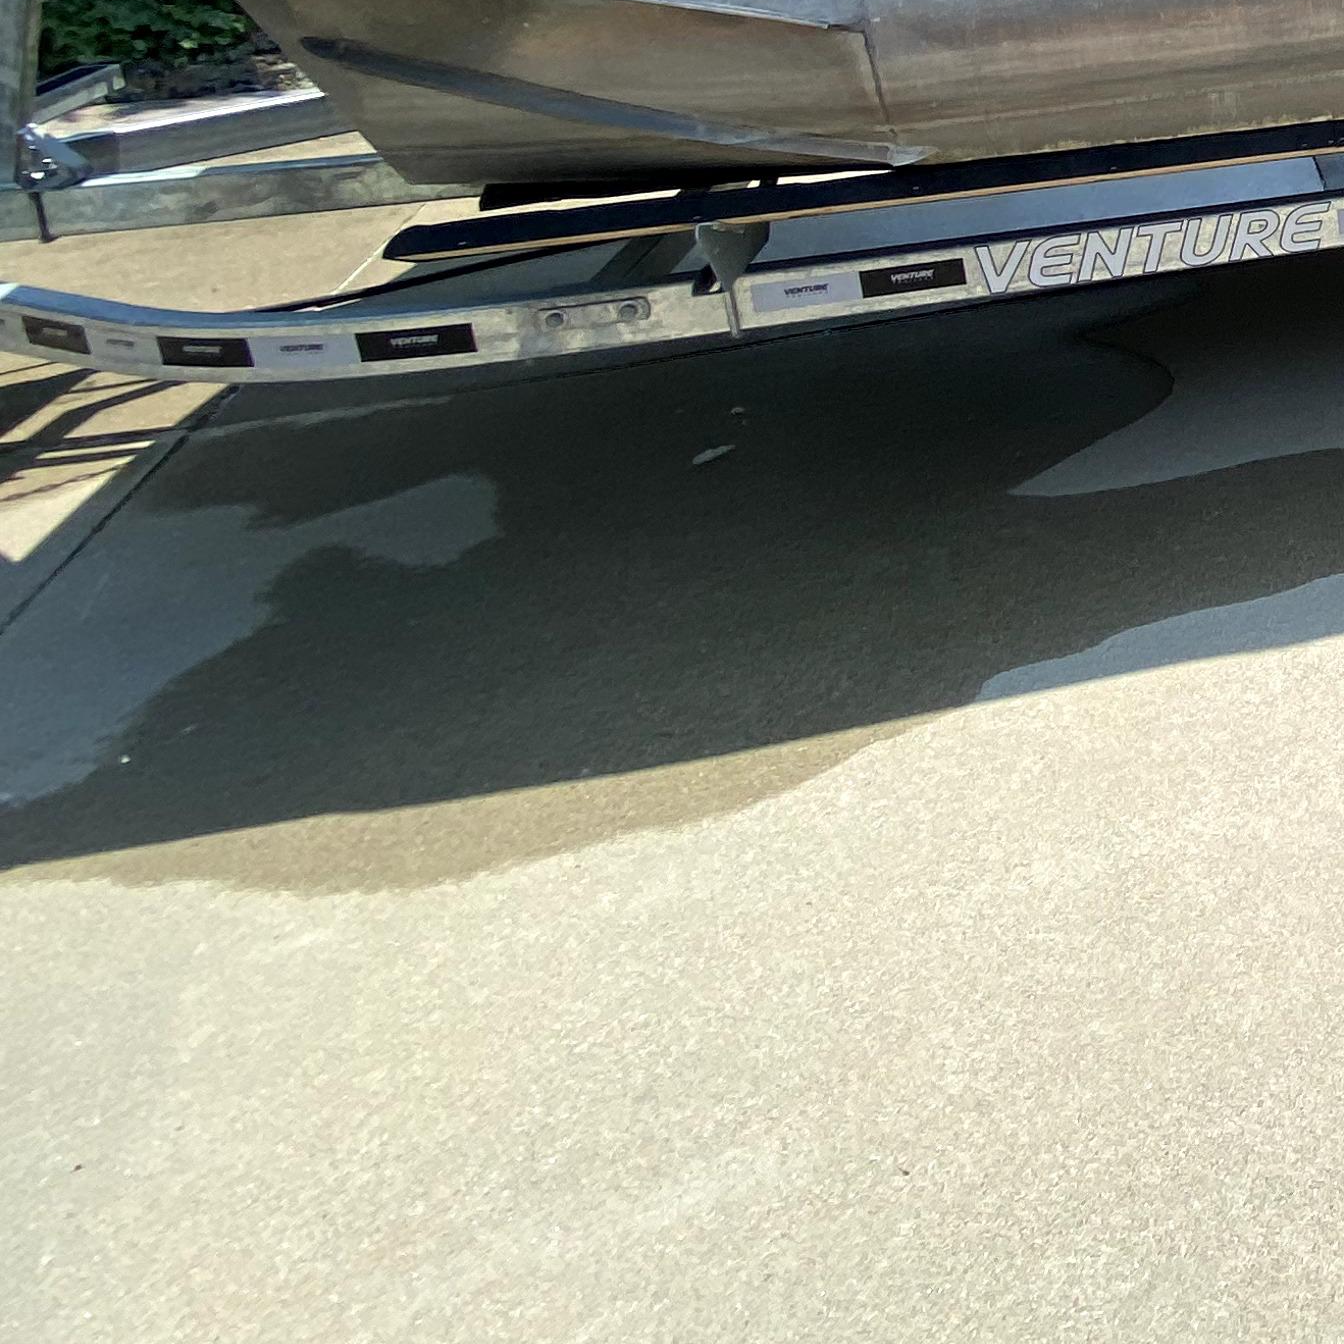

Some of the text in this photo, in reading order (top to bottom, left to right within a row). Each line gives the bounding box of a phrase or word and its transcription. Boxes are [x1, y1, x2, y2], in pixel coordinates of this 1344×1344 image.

[974, 200, 1332, 295] VENTURE
[890, 269, 935, 282] VENTURE
[784, 283, 829, 295] VENTURE
